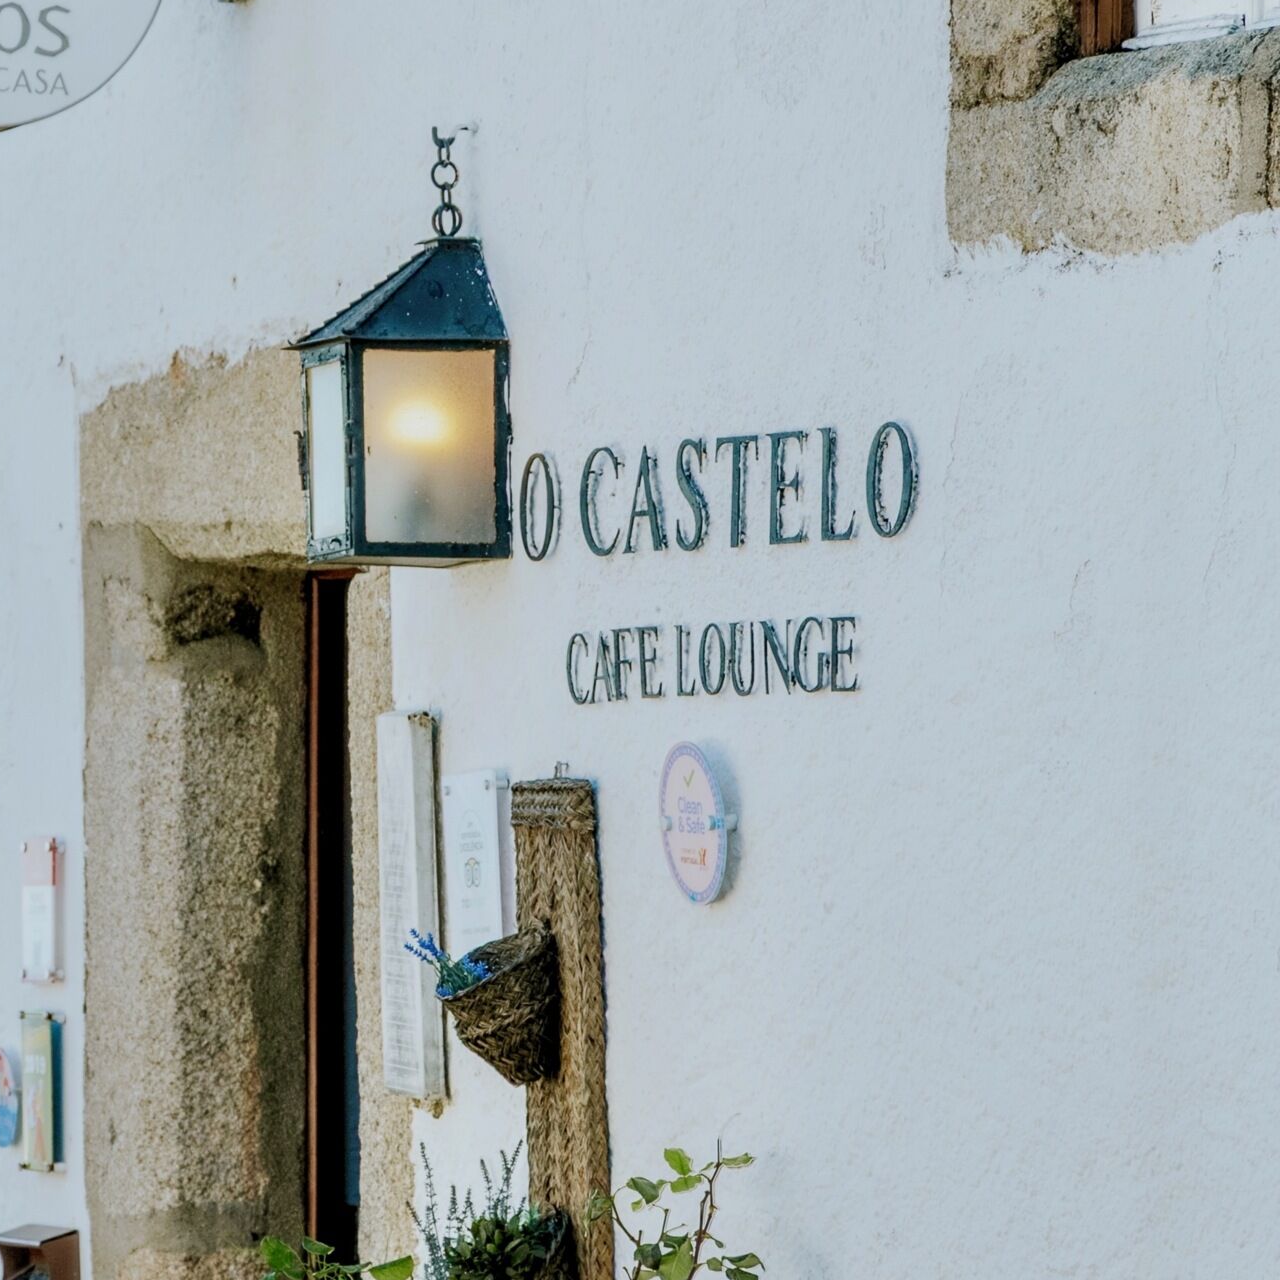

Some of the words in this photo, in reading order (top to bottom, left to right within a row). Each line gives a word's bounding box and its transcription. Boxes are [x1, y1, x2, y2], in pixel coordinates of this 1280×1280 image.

[519, 452, 556, 562] O
[580, 421, 916, 557] CASTELO
[566, 626, 663, 705] CAFE
[674, 616, 859, 697] LOUNGE
[677, 795, 703, 816] Clean
[686, 816, 706, 835] Safe
